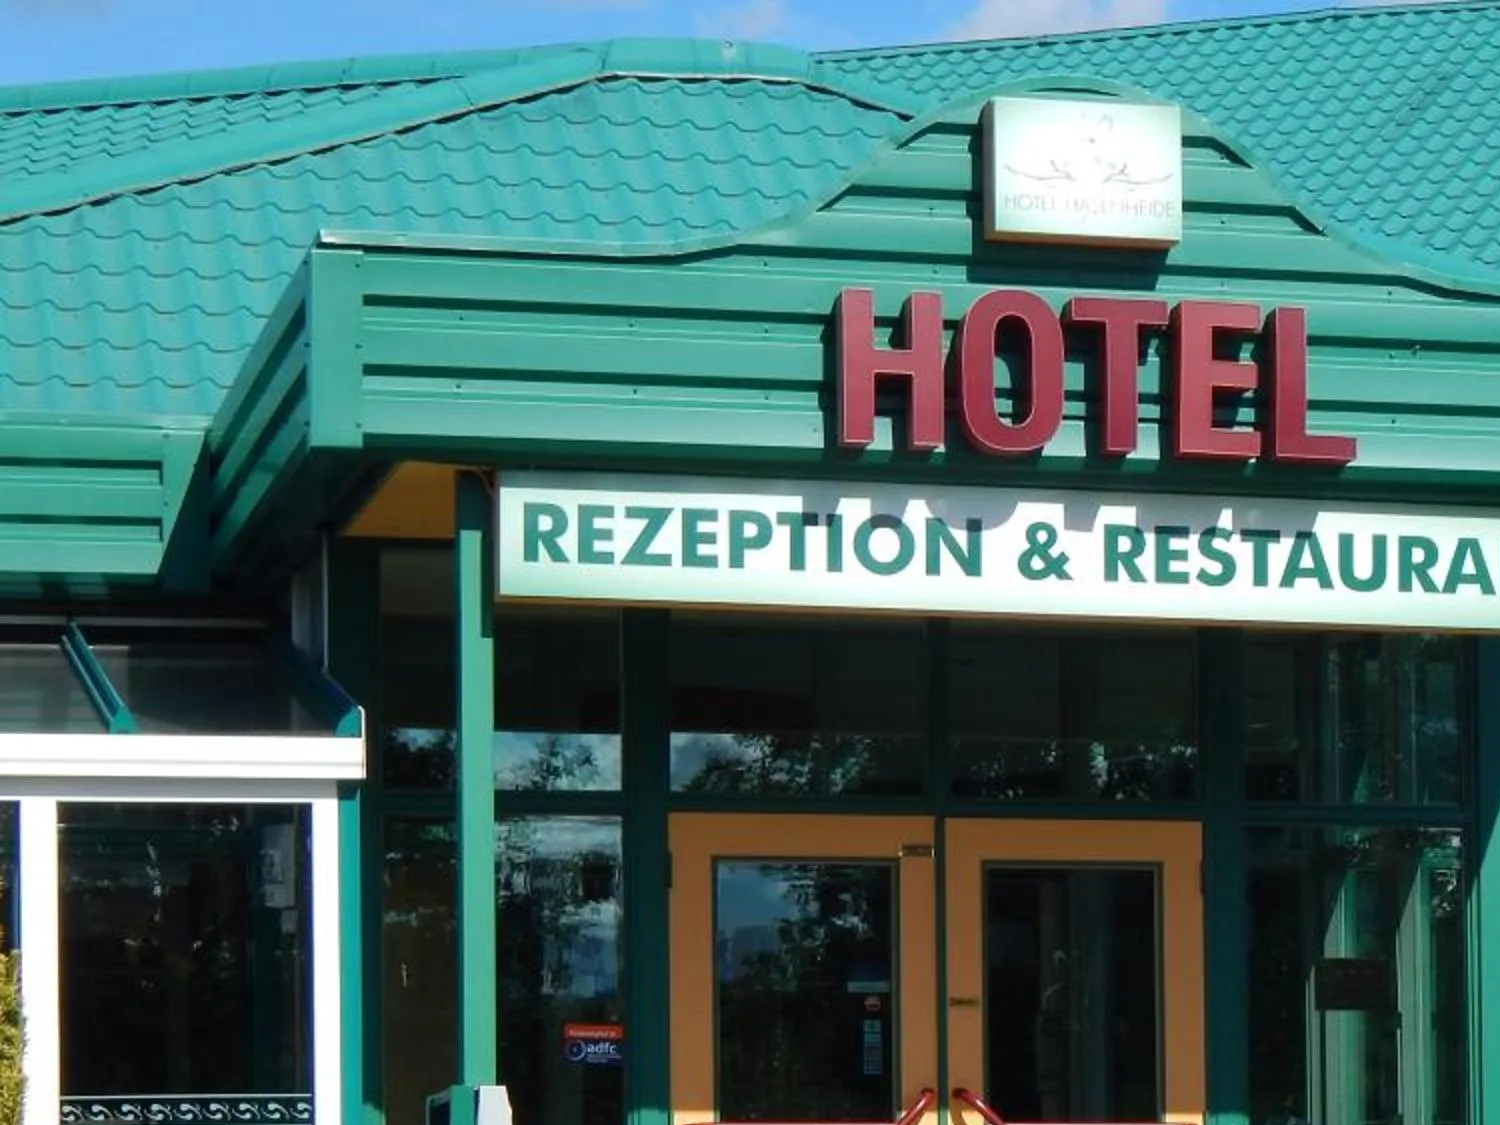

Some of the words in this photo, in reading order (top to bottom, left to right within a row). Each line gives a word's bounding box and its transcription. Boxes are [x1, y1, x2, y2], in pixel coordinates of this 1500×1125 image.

[1066, 197, 1175, 218] HAENHEIDE
[836, 288, 1357, 465] HOTEL
[522, 501, 983, 577] REZEPTION
[1017, 521, 1073, 582] &
[587, 1041, 616, 1053] adfc
